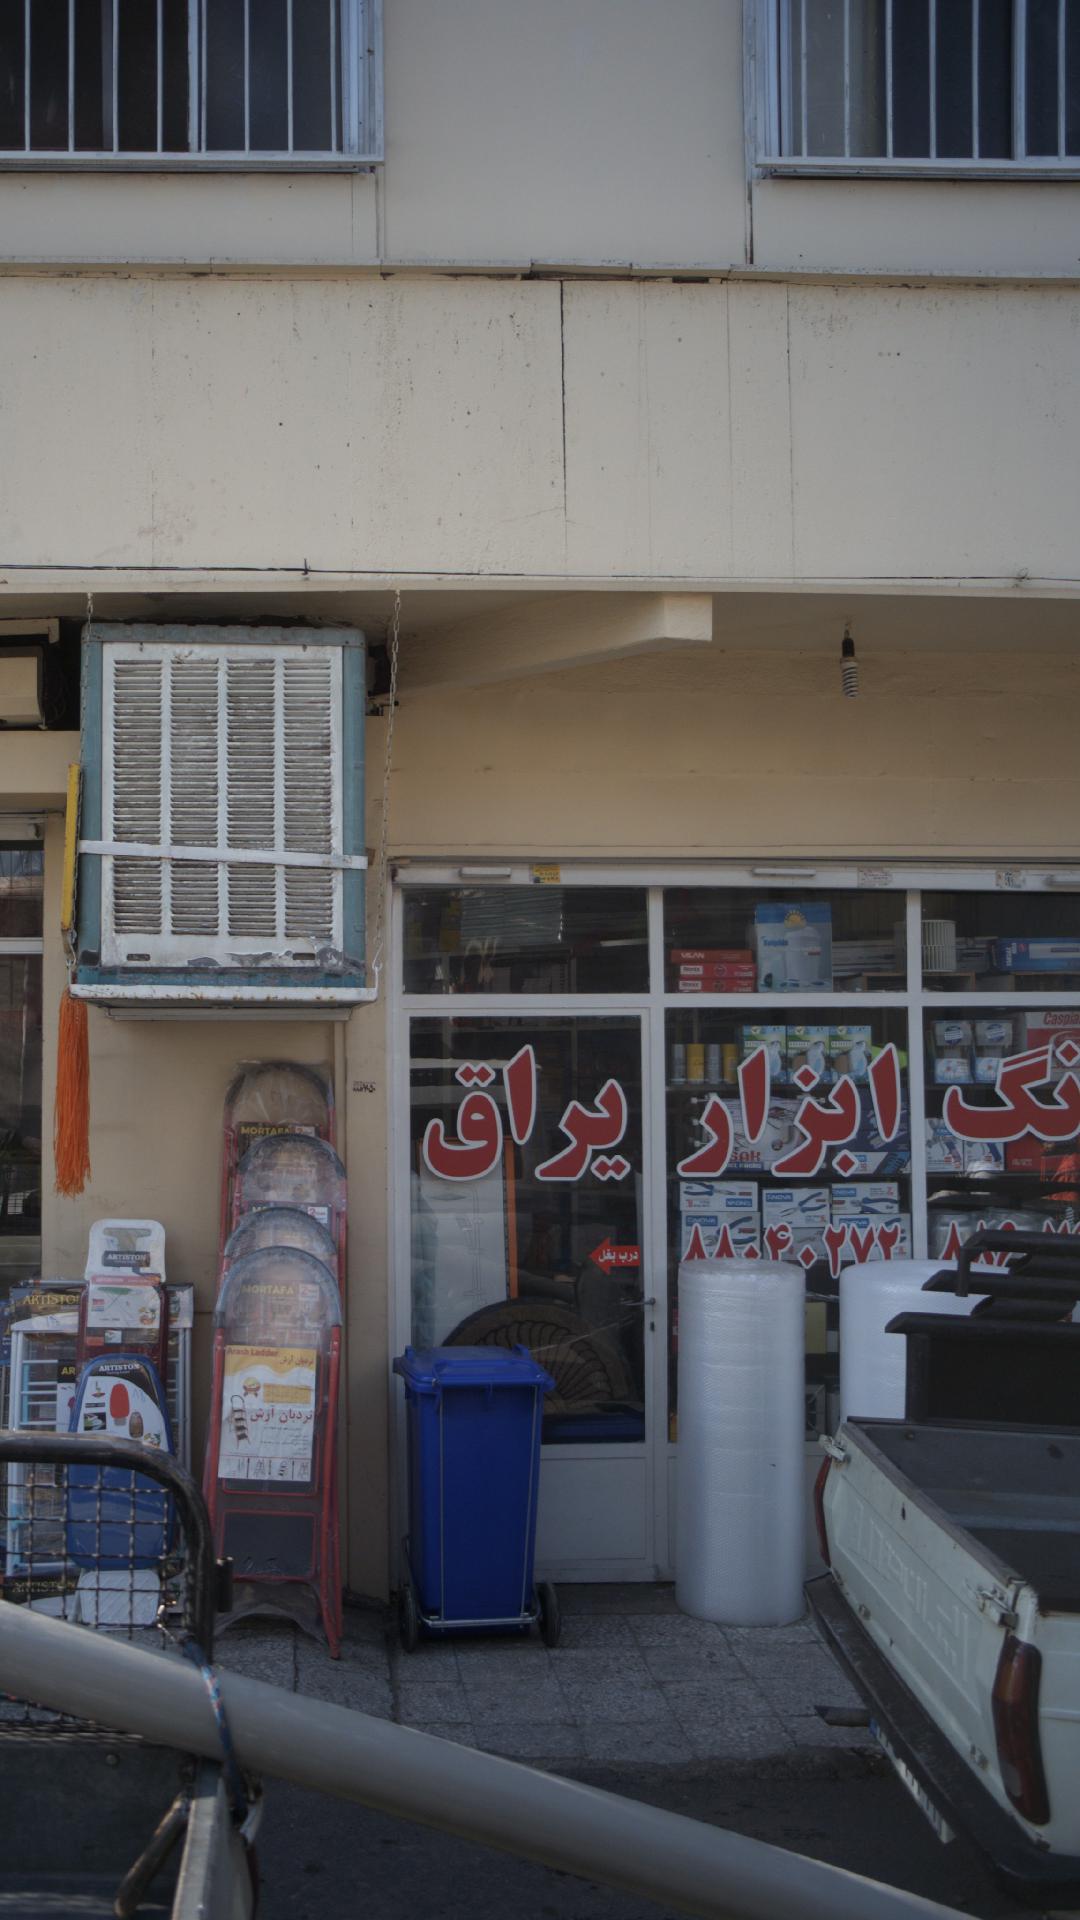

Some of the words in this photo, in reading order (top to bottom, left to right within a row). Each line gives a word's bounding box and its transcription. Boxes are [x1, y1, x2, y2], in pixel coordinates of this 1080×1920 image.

[422, 1043, 632, 1183] یراق
[676, 1042, 902, 1178] ابزار
[98, 1363, 140, 1373] ARTISTON
[249, 1404, 275, 1422] آرش
[279, 1408, 314, 1424] نردبان
